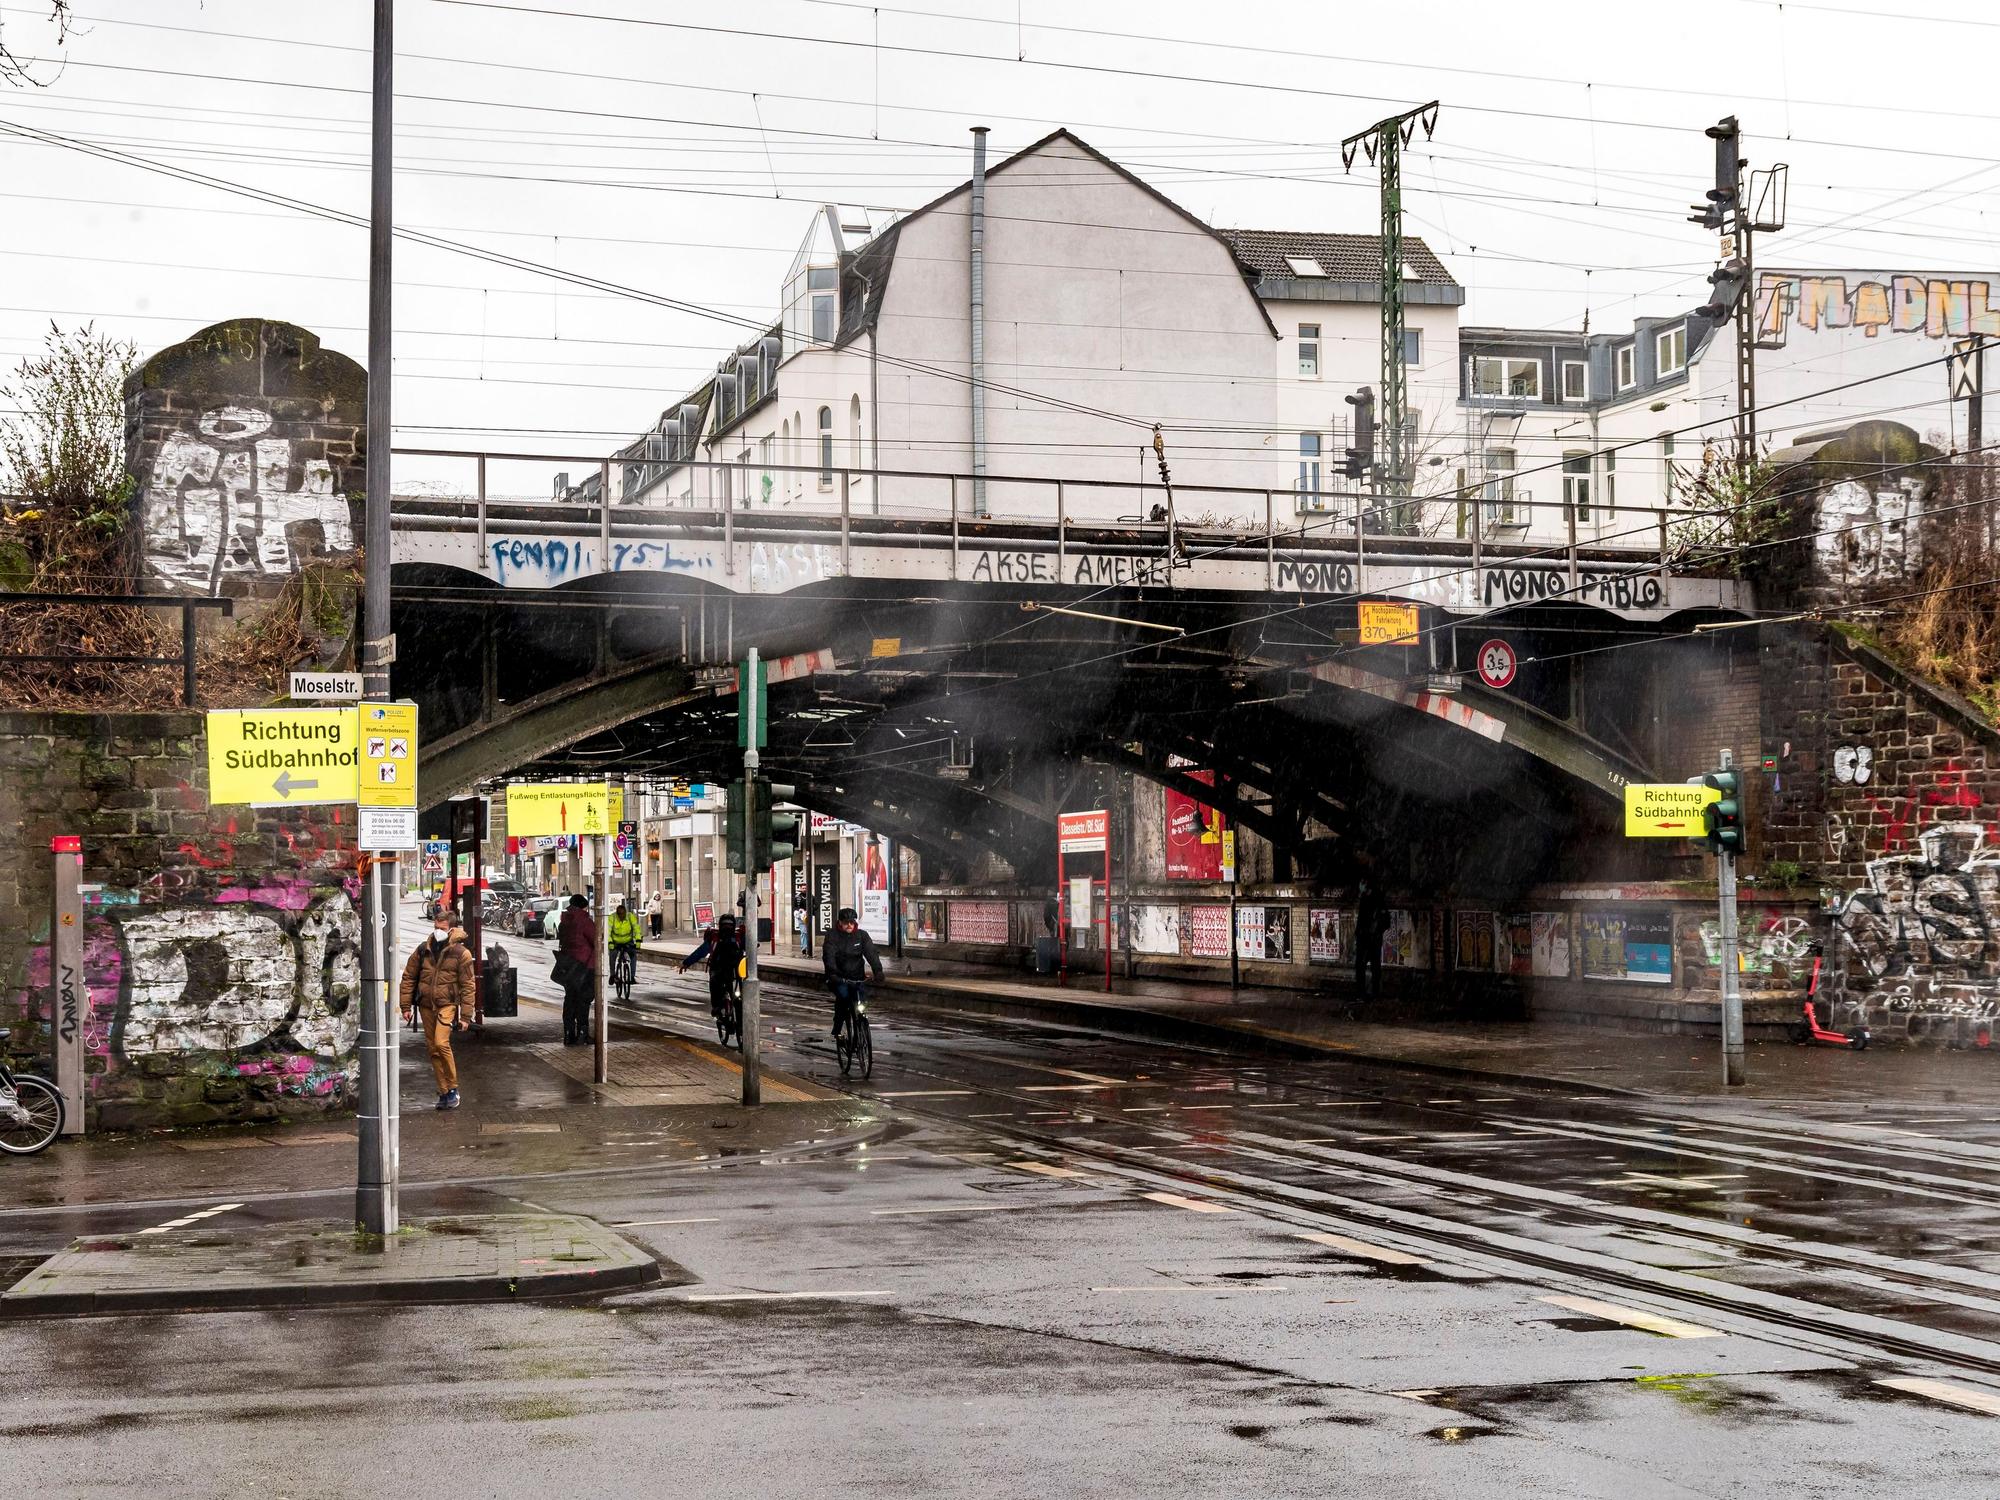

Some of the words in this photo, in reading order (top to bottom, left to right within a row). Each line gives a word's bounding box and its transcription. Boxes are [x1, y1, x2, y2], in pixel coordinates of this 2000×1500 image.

[1277, 561, 1353, 592] MONO
[1484, 569, 1566, 606] MONO
[1582, 571, 1662, 610] PABLO
[294, 677, 359, 694] Moselstr.
[242, 721, 341, 744] Richtung
[225, 748, 358, 769] Südbahnhof
[509, 792, 539, 801] Fußweg
[540, 790, 606, 801] Entlastungsfläche
[1644, 790, 1702, 804] Richtung
[625, 848, 631, 859] P
[632, 863, 642, 875] H
